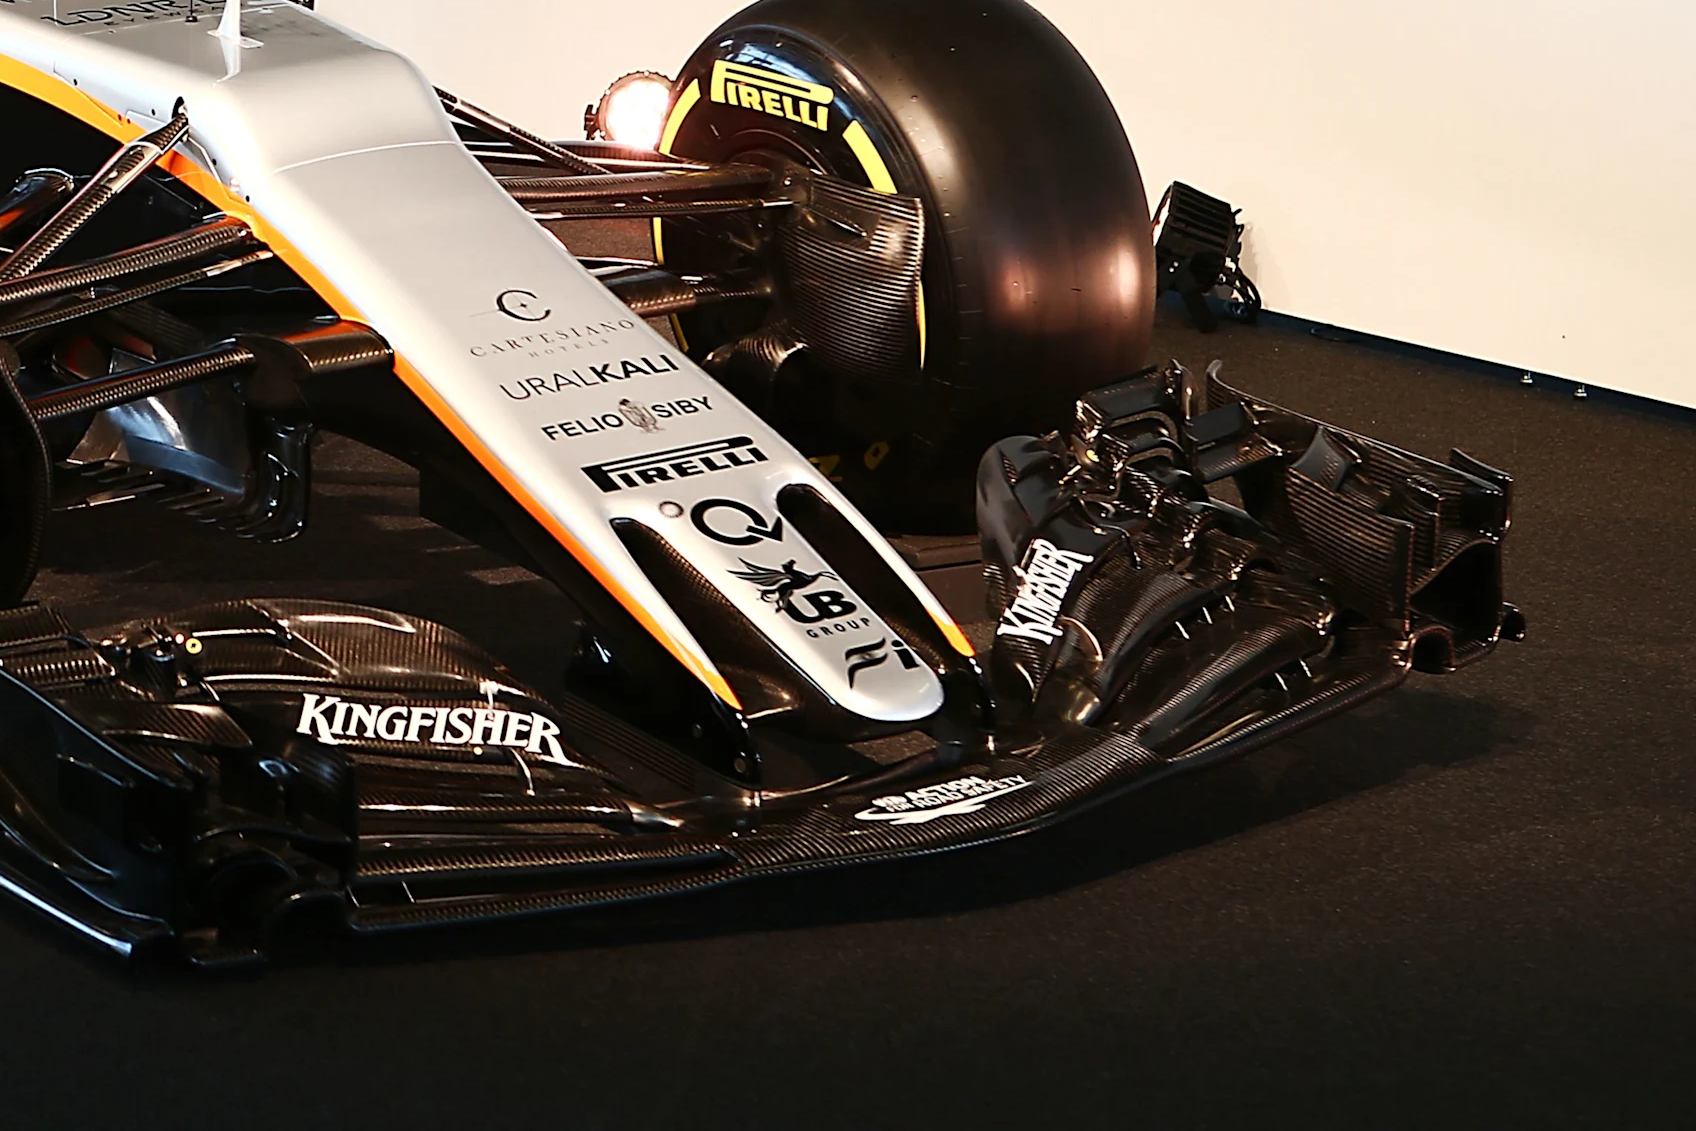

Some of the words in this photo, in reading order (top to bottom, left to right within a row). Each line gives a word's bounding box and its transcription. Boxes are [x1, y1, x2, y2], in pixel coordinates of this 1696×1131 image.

[710, 59, 836, 132] PIRELLI
[469, 318, 636, 359] CARTESIANO
[527, 338, 611, 359] HOTELS
[499, 354, 680, 401] URALKALI
[541, 412, 625, 441] FELIO
[650, 396, 715, 420] SIBY
[580, 435, 770, 493] PIRELLI
[996, 538, 1095, 645] KINGFISHER
[805, 617, 871, 639] GROUP
[296, 692, 591, 770] KINGFISHER
[904, 775, 987, 803] ACTION
[911, 788, 965, 809] ROAD
[960, 774, 1028, 798] SAFETY
